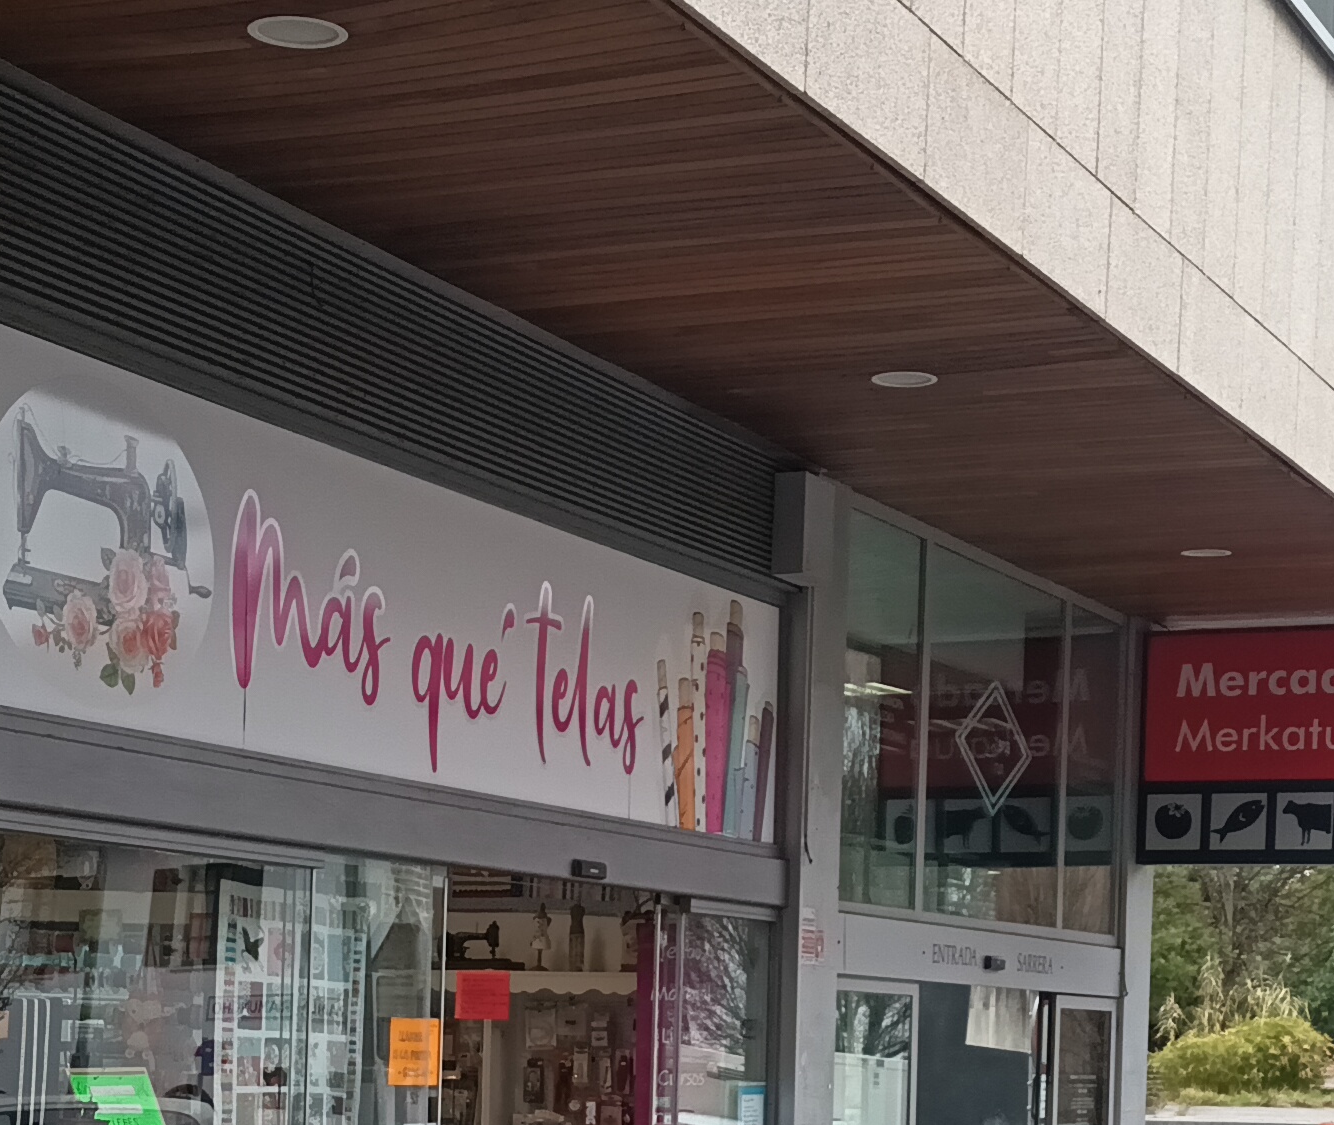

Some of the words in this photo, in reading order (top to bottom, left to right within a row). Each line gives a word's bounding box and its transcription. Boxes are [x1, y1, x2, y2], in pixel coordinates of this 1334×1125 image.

[229, 488, 391, 707] Más
[410, 602, 517, 774] qué
[931, 943, 978, 967] ENTRADA
[1017, 952, 1054, 975] SARRERA
